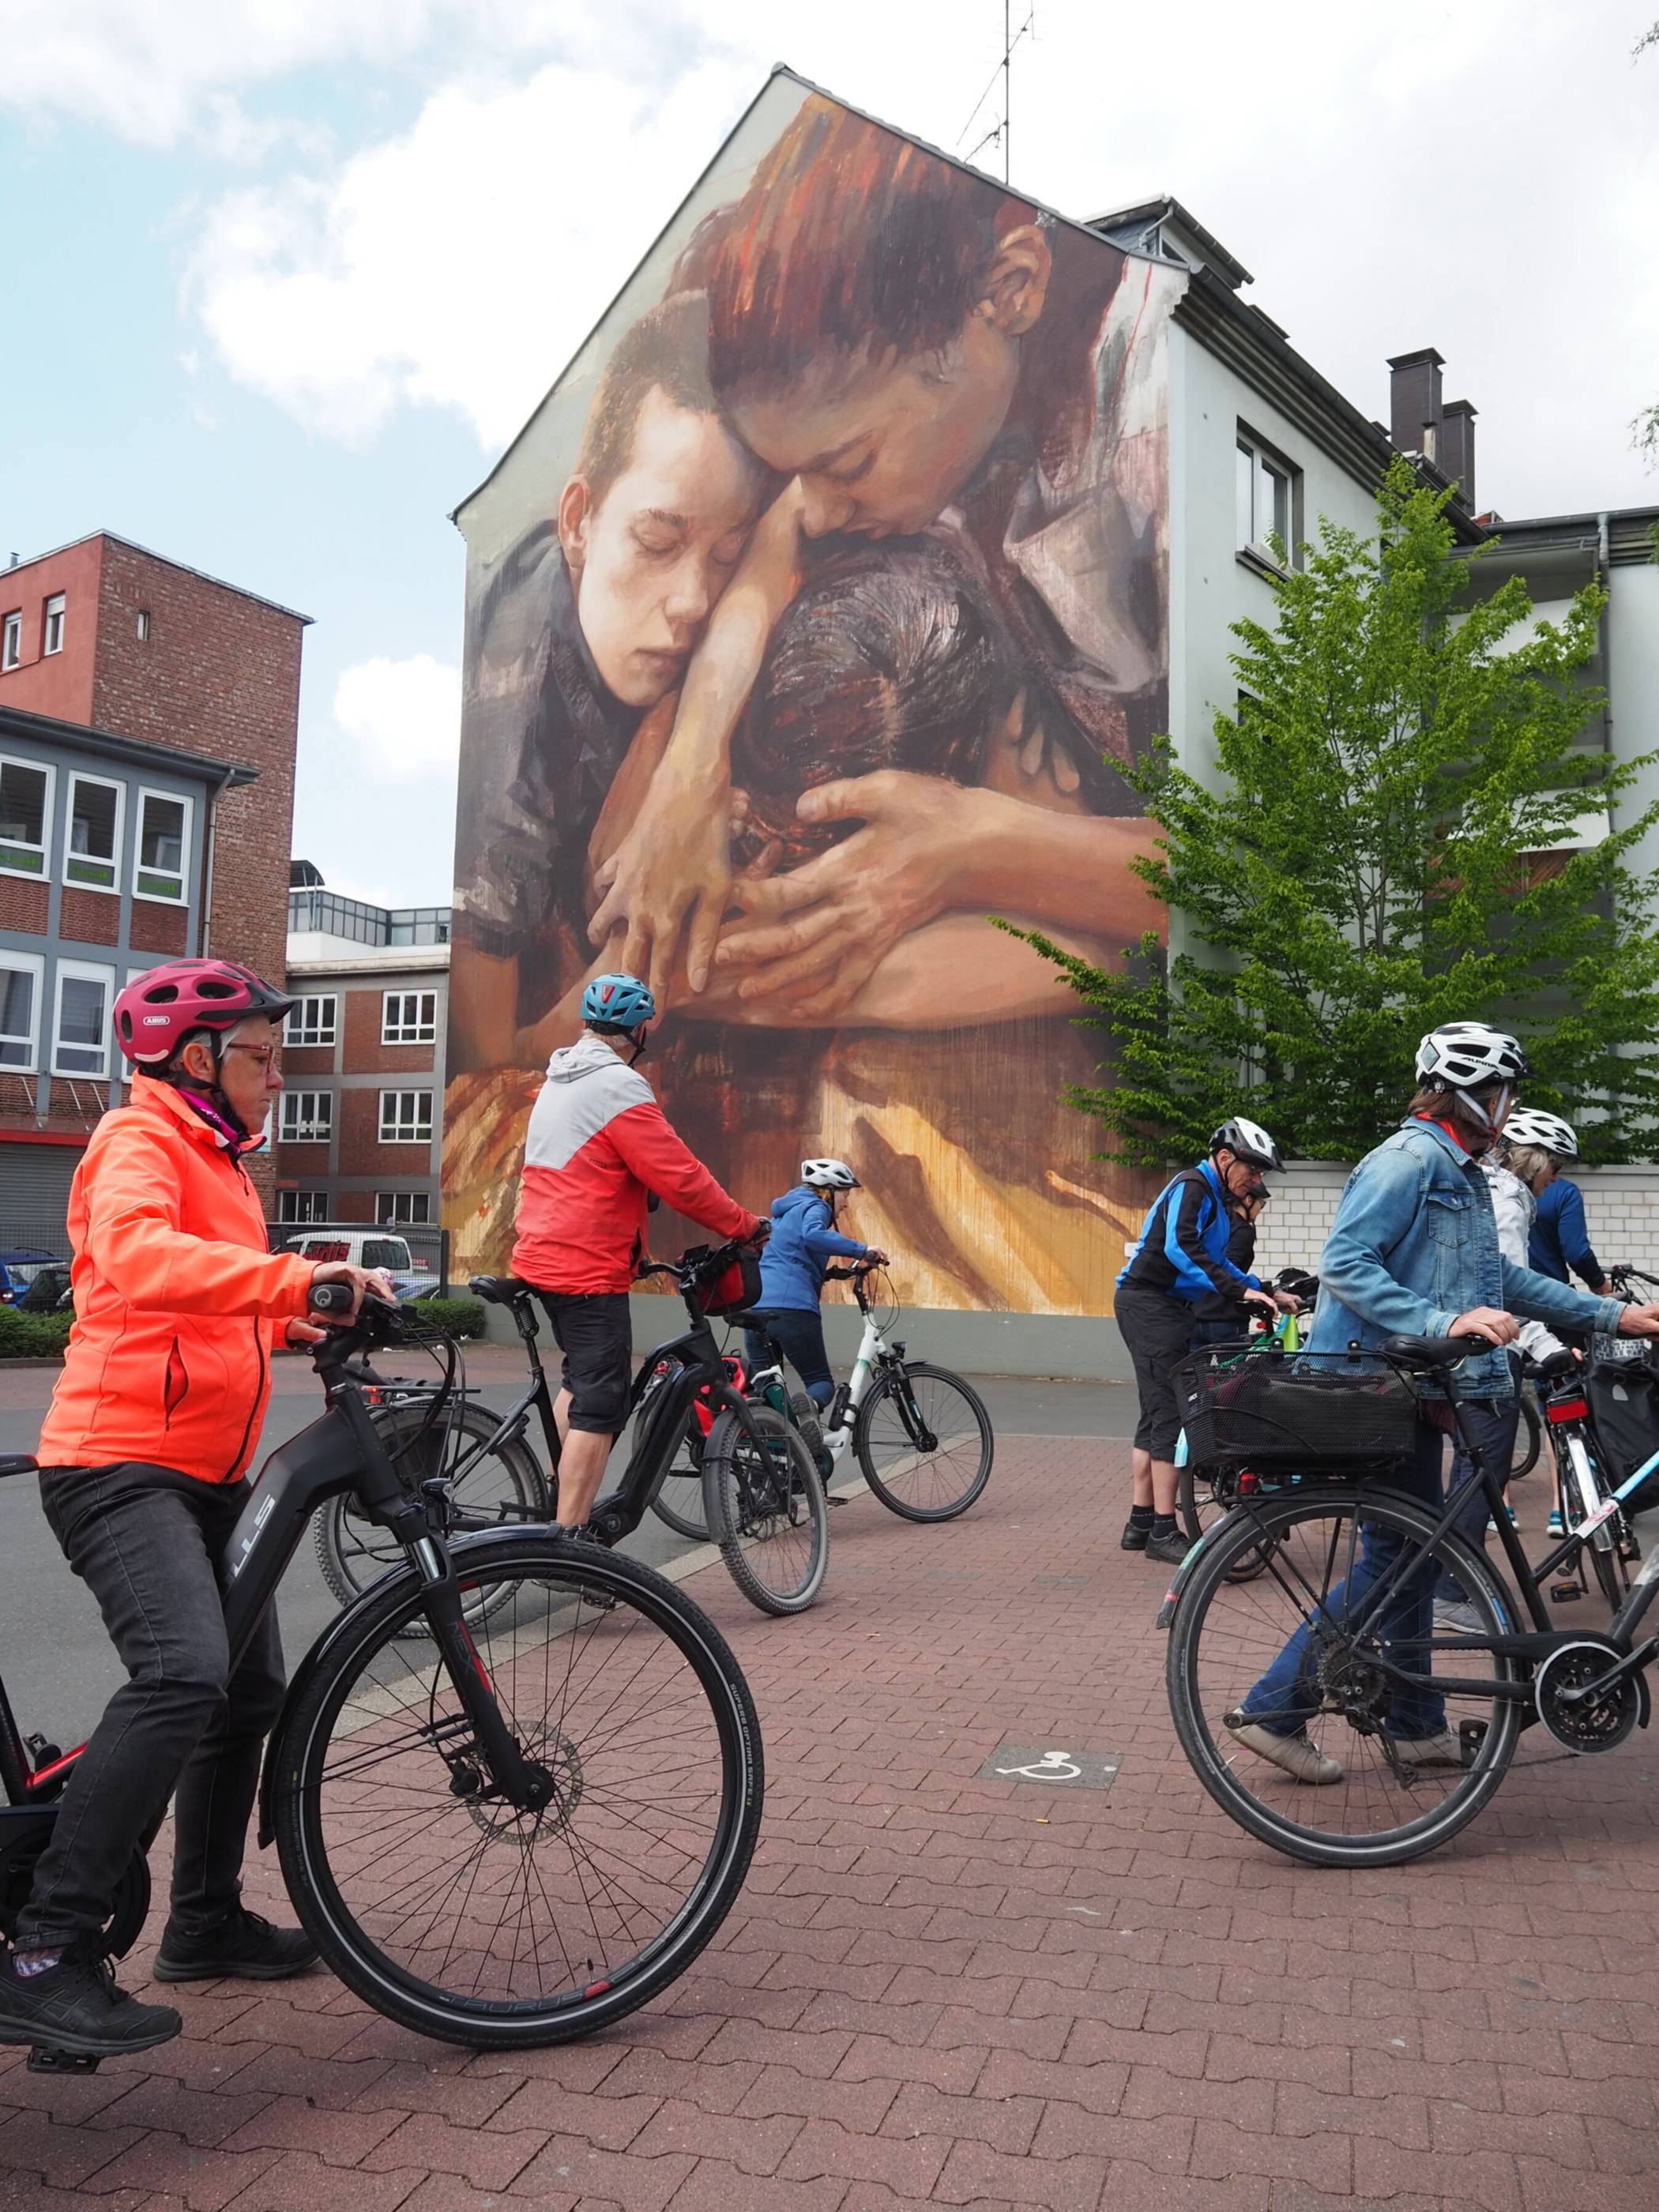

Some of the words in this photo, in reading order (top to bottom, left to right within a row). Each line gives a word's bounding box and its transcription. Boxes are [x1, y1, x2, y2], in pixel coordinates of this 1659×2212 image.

[1461, 1057, 1499, 1070] ALPINA
[730, 1683, 747, 1725] SUPERB
[743, 1726, 753, 1765] OPTIMA
[447, 1988, 583, 2013] TAURUS
